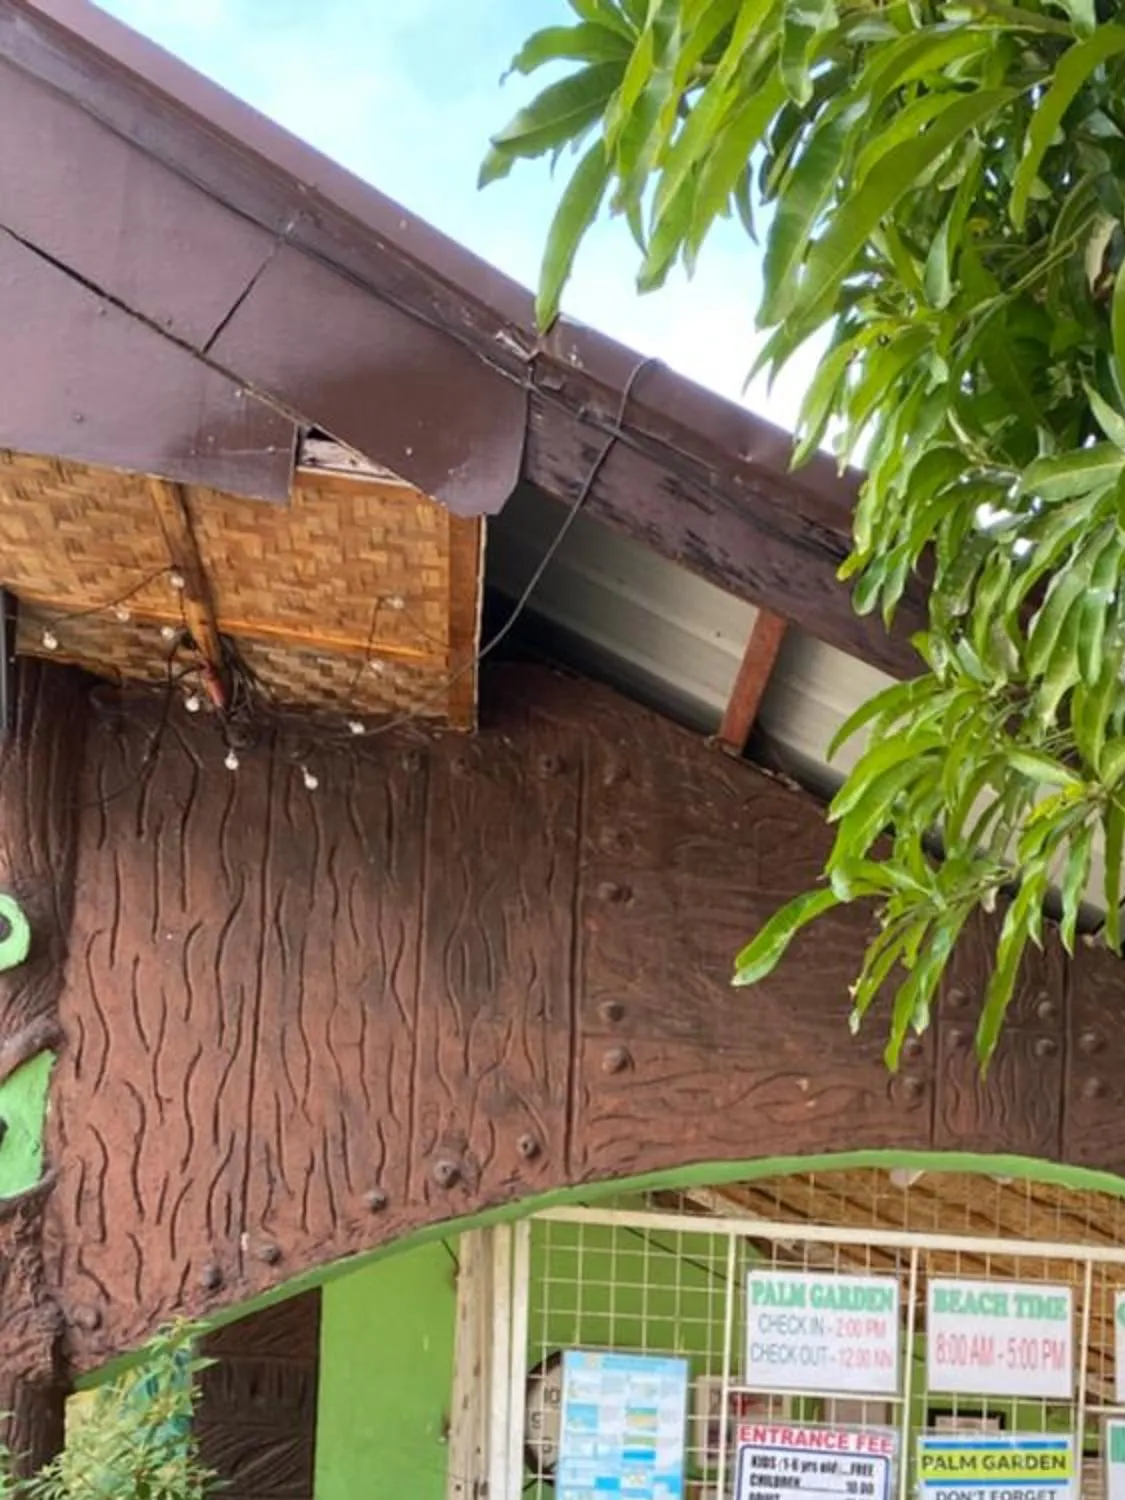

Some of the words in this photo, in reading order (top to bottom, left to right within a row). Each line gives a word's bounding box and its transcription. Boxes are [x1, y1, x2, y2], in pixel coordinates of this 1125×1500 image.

[751, 1279, 806, 1307] PALM
[809, 1283, 894, 1312] GARDEN
[934, 1288, 1008, 1317] BEACH
[1014, 1292, 1067, 1320] TIME
[758, 1312, 806, 1335] CHECK
[750, 1342, 797, 1364] CHECK
[800, 1345, 828, 1366] OUT
[936, 1332, 967, 1365] 8:00
[970, 1334, 995, 1366] AM
[1007, 1337, 1039, 1370] 5:00
[1042, 1338, 1066, 1372] PM
[740, 1426, 848, 1449] ENTRANCE
[856, 1435, 893, 1452] FEE
[921, 1455, 977, 1471] PALM
[981, 1454, 1066, 1471] GARDEN
